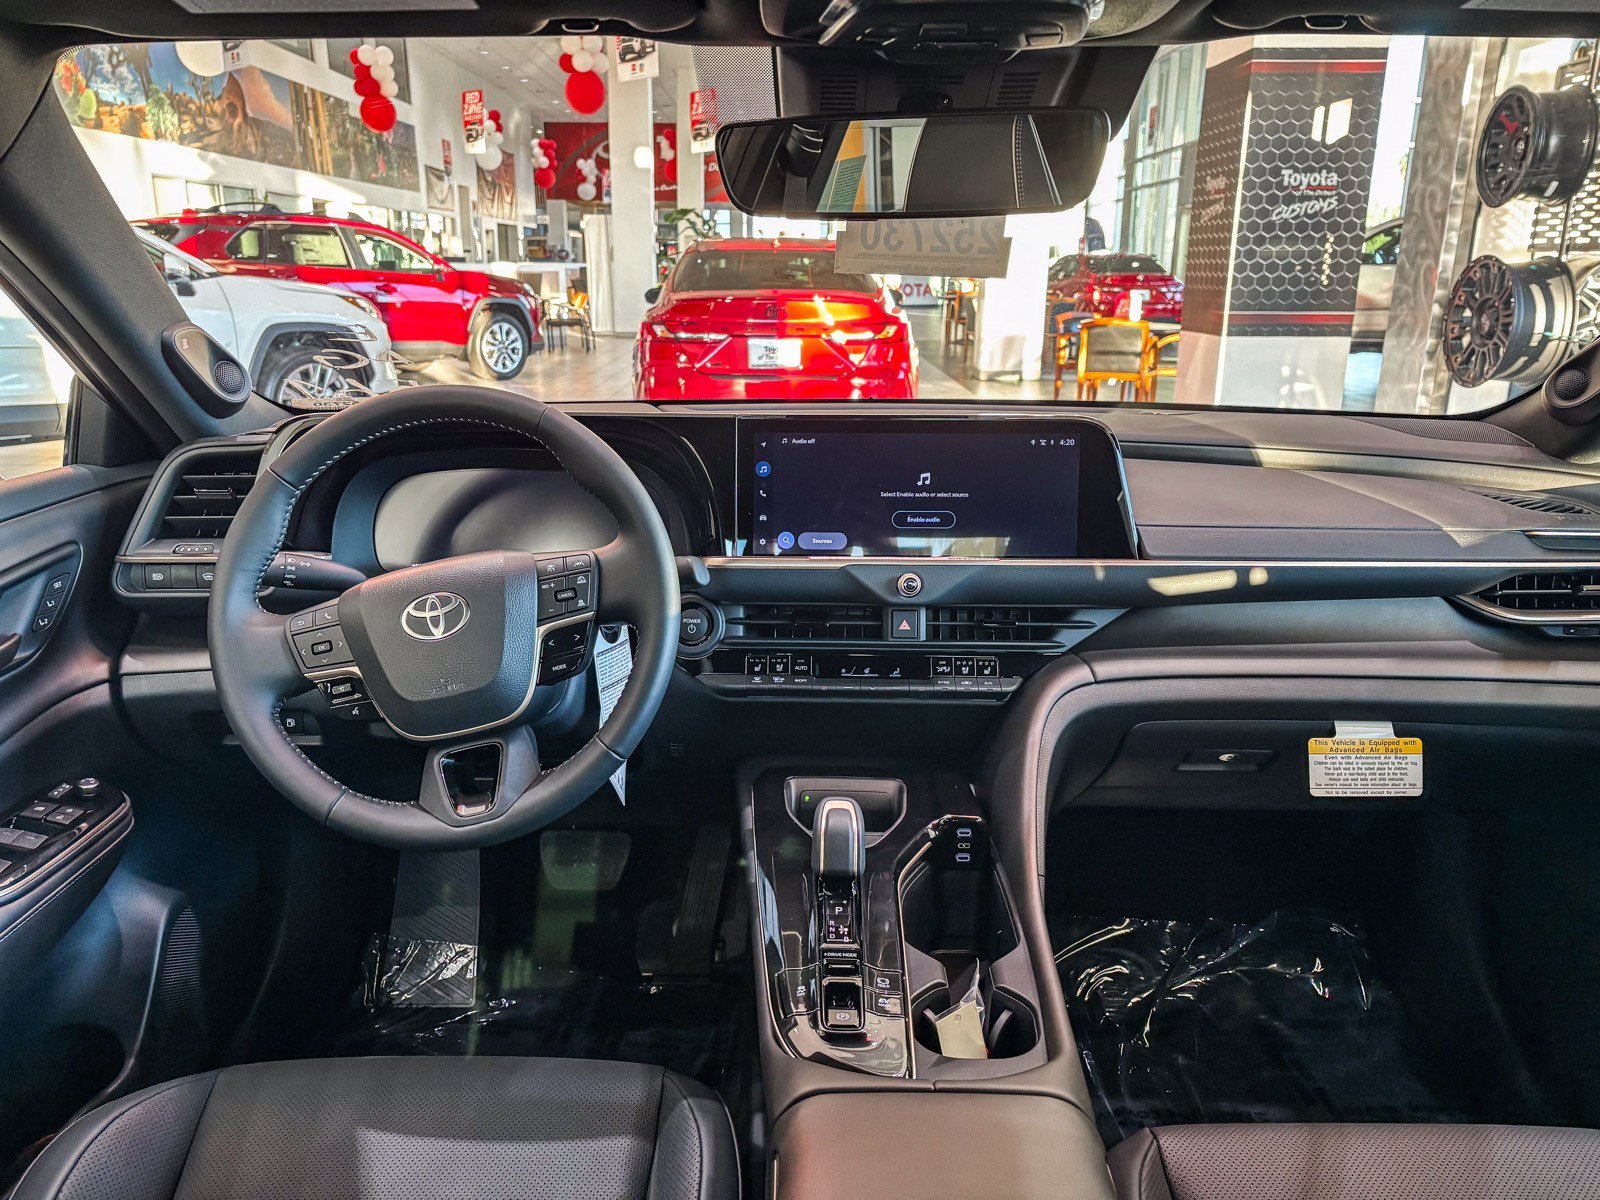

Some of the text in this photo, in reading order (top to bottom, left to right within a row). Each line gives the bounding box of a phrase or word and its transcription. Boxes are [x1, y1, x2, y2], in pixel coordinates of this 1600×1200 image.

[465, 91, 480, 103] RED
[1281, 168, 1338, 189] Toyota
[1271, 195, 1339, 220] CUSTOMS
[902, 283, 932, 298] OTA
[53, 581, 62, 589] SET
[551, 663, 567, 672] MODE
[835, 906, 843, 915] P
